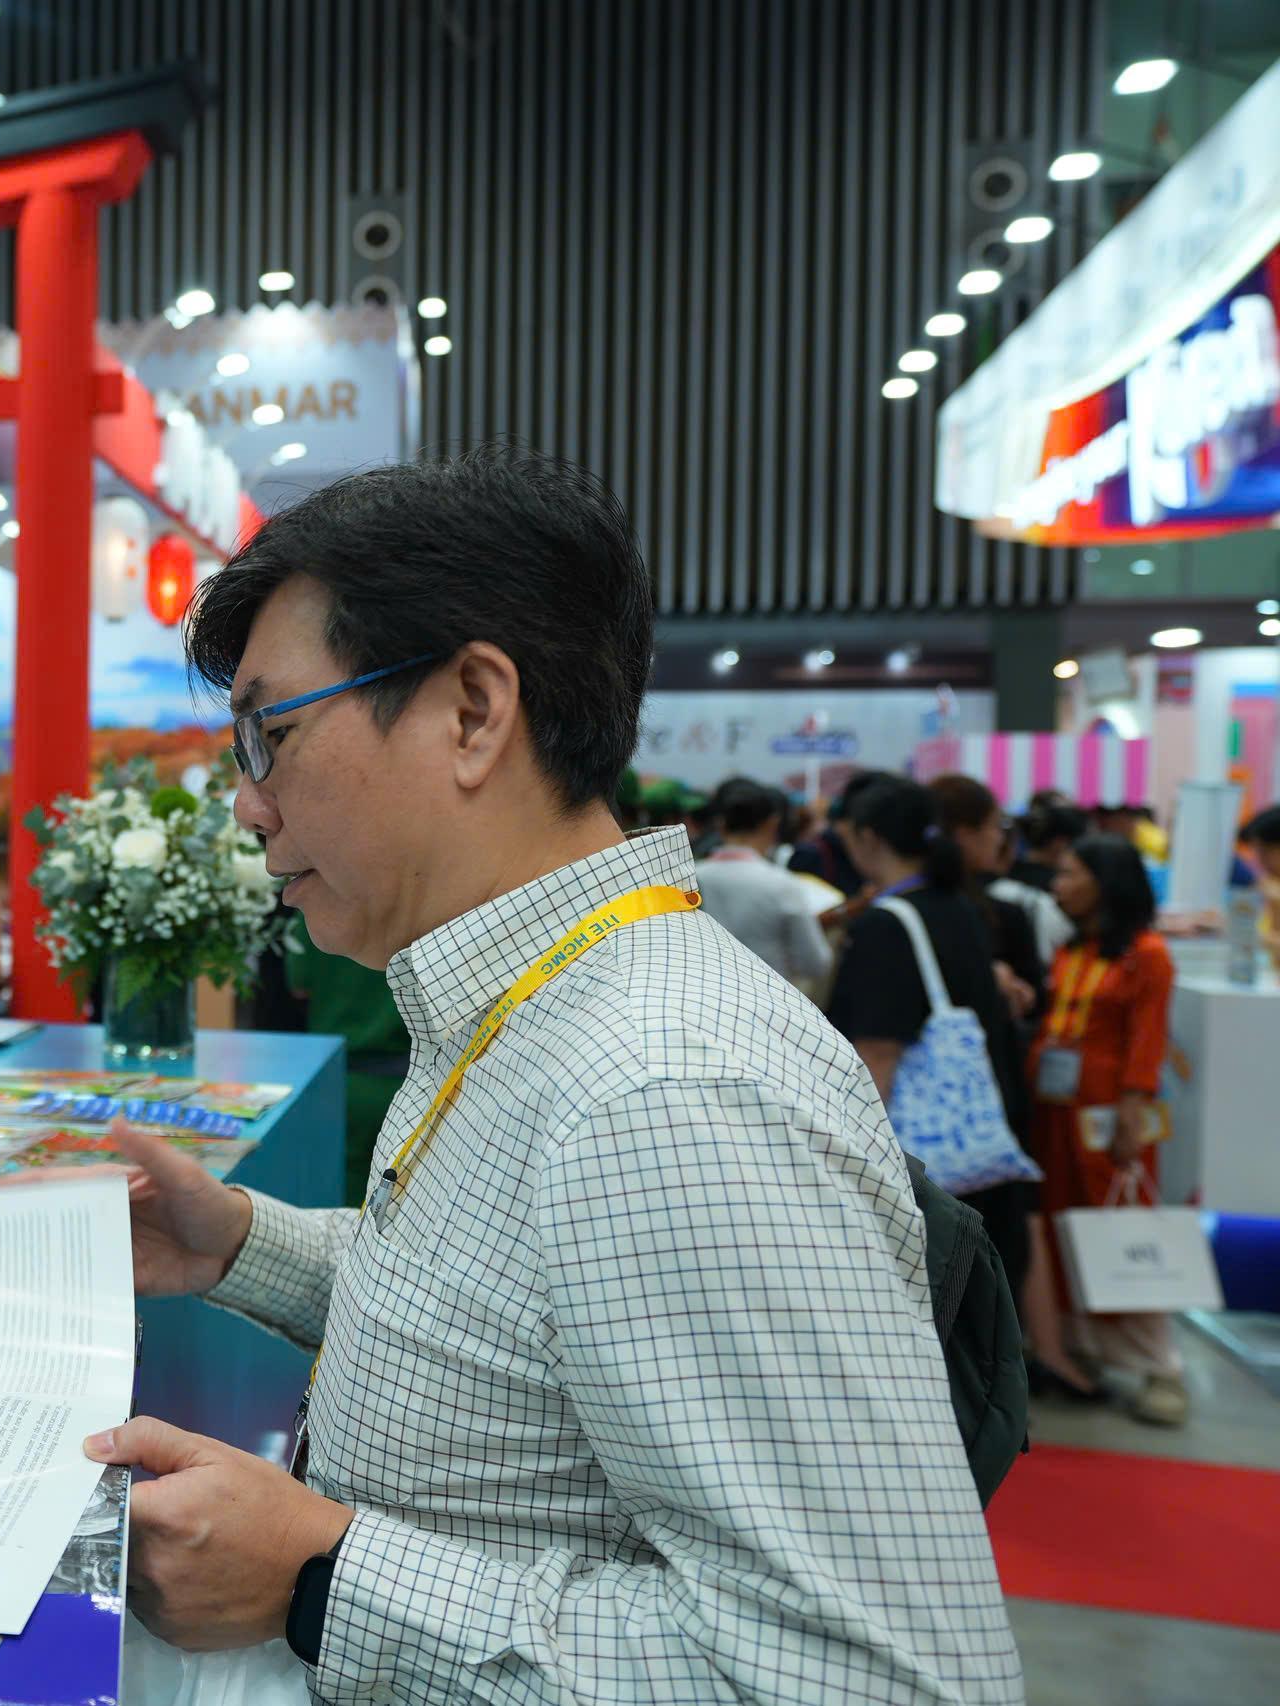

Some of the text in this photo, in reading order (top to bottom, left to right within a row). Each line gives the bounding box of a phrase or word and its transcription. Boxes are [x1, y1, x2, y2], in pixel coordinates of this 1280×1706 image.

[175, 379, 358, 428] ANMAR
[540, 913, 620, 976] ITE HCMC
[491, 997, 515, 1025] ITE
